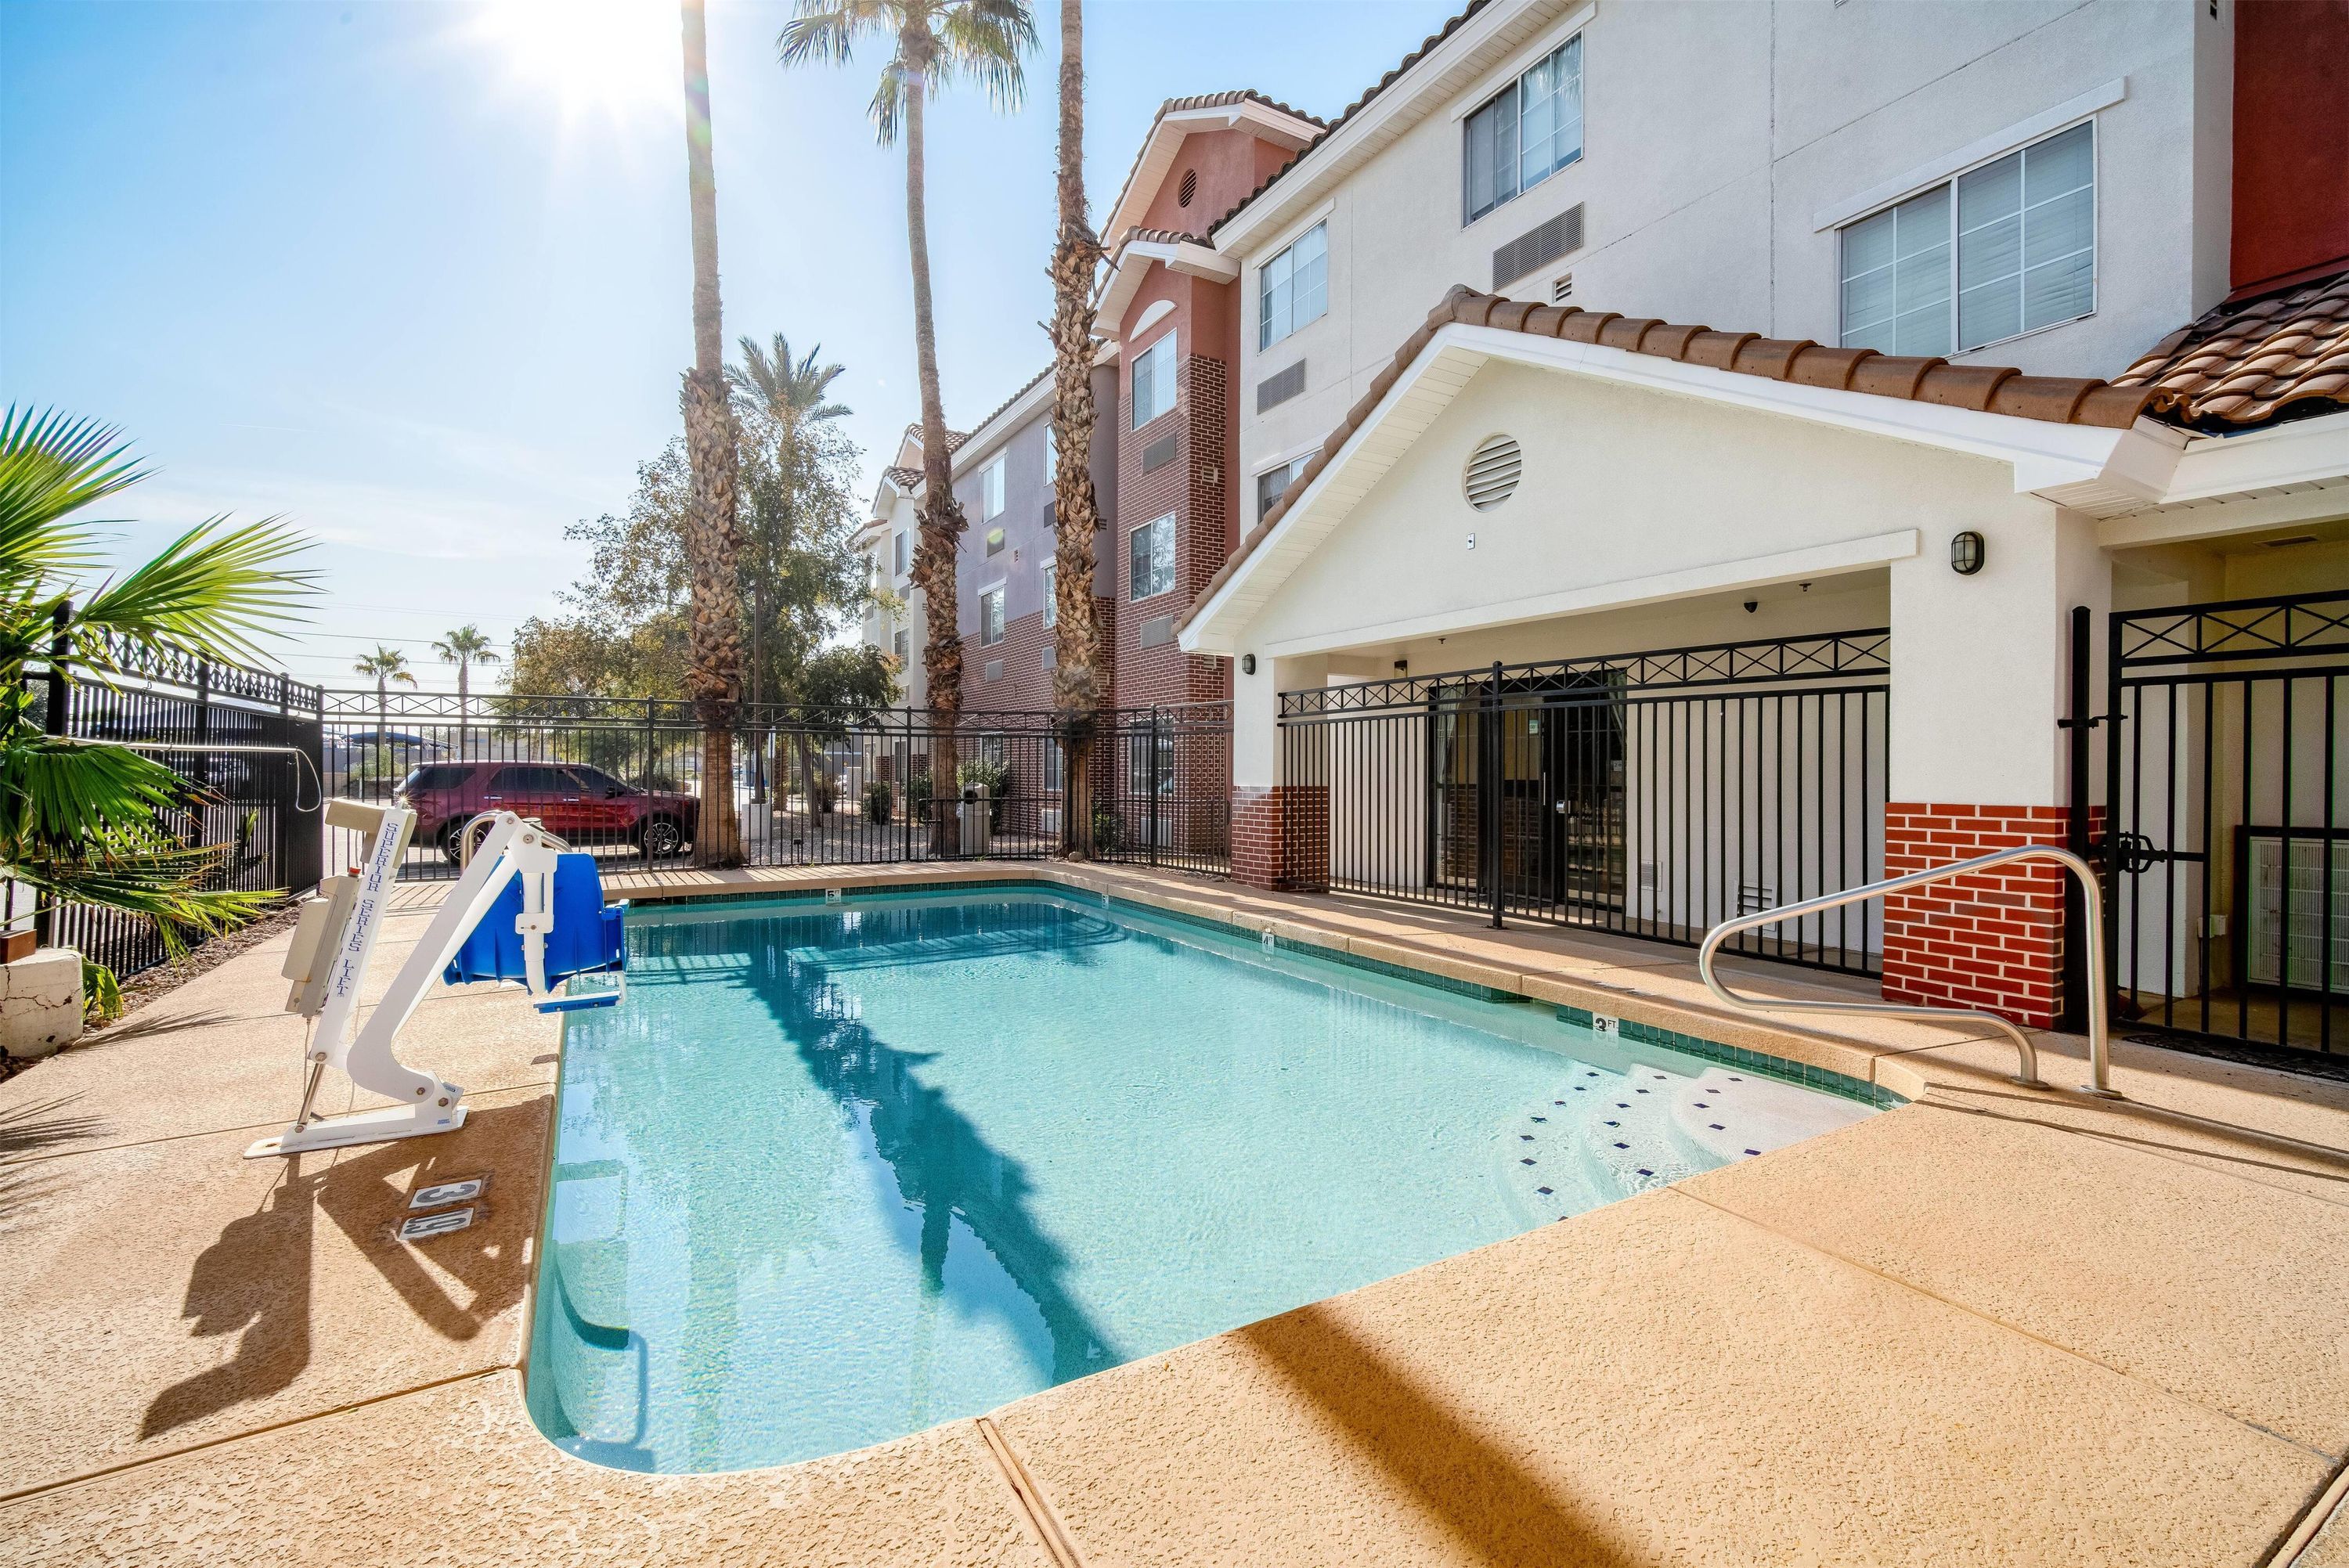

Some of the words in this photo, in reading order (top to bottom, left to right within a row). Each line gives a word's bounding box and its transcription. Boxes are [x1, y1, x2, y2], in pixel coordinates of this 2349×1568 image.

[367, 822, 399, 892] SUPERIOR
[348, 899, 375, 952] SERIES
[337, 959, 355, 995] LIFT
[1607, 1019, 1616, 1028] FT
[417, 1184, 477, 1203] 3
